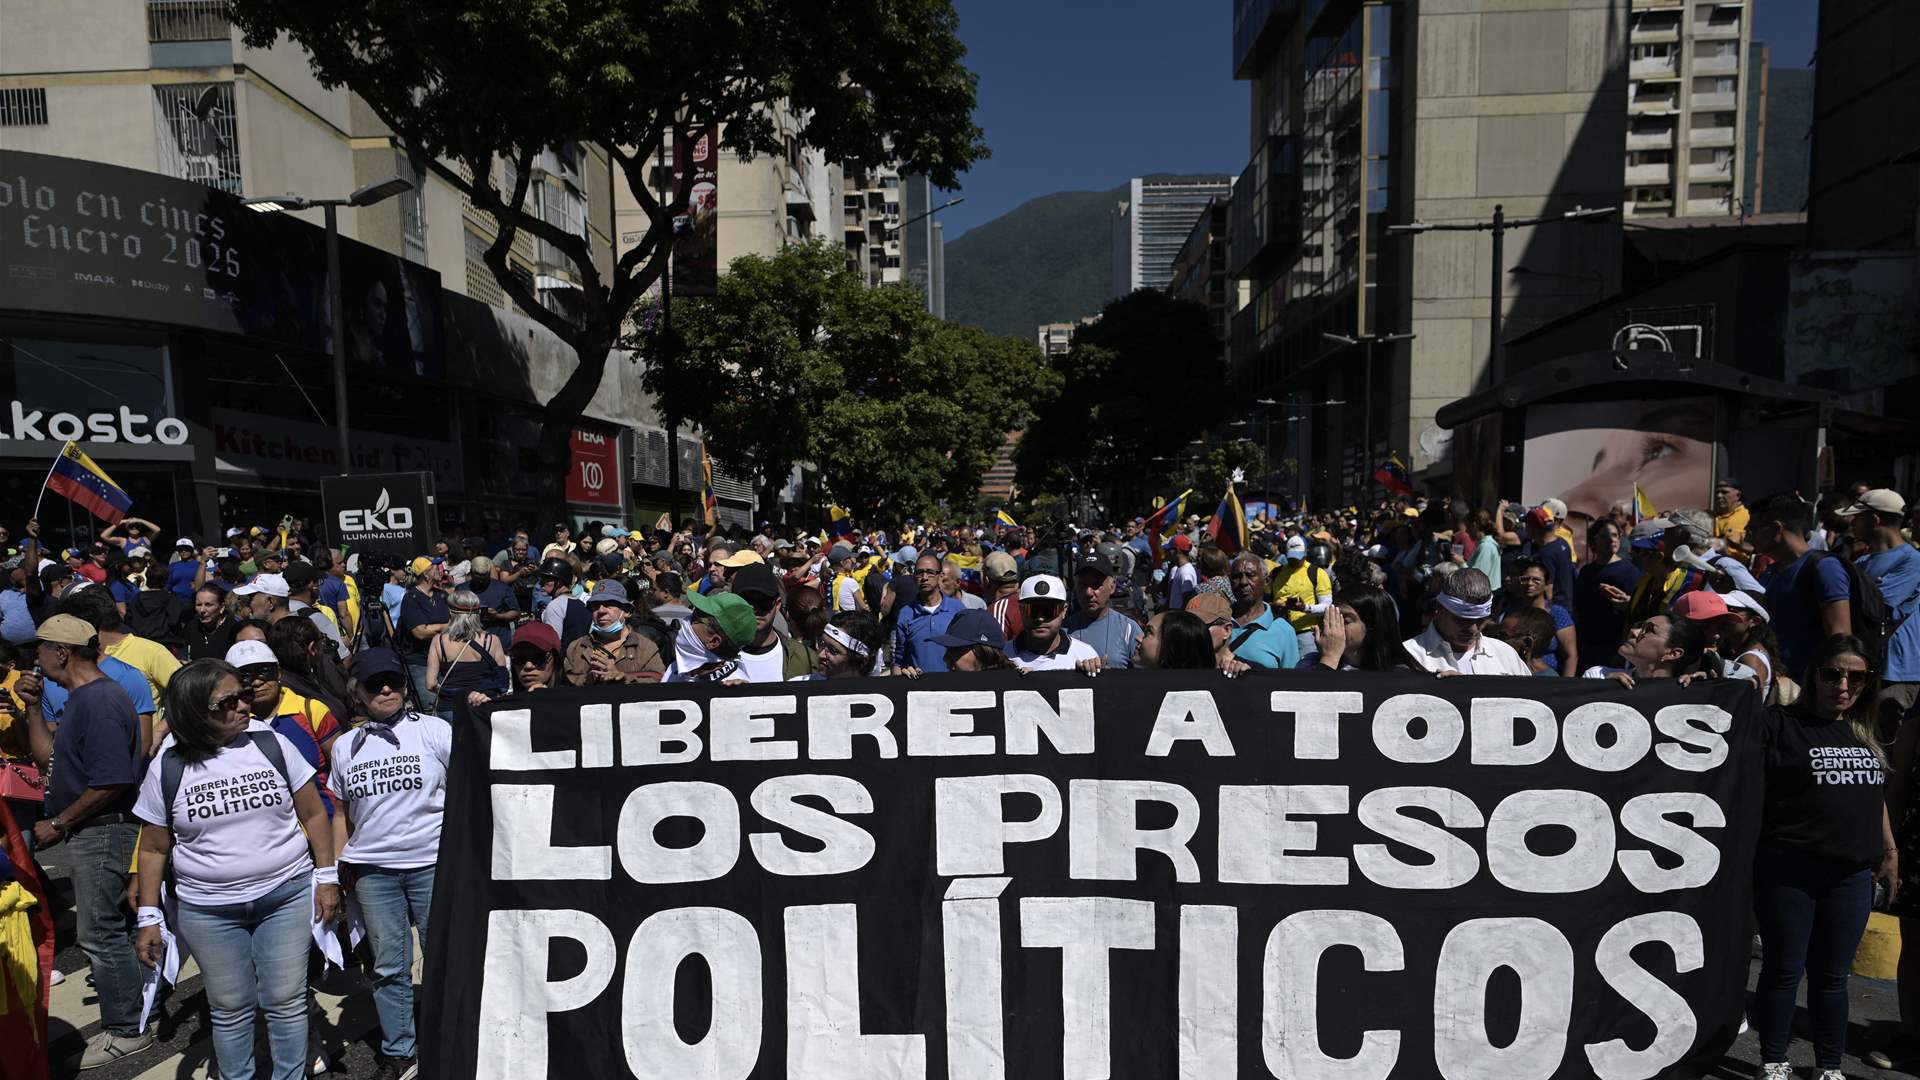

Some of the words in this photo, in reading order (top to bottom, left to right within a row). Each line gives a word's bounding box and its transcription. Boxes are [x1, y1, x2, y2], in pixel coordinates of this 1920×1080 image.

[23, 214, 142, 259] Enero
[162, 233, 240, 278] 2026
[74, 272, 116, 285] IMAX
[580, 461, 604, 490] 100
[338, 506, 413, 531] EKO
[342, 529, 413, 541] ILUMINACIÓN
[490, 688, 1096, 772] LIBEREN
[1145, 690, 1237, 757] A
[1271, 691, 1733, 773] TODOS
[347, 760, 381, 775] LIBEREN
[383, 758, 389, 766] A
[391, 755, 420, 765] TODOS
[1809, 746, 1871, 758] CIERREN
[1811, 757, 1880, 770] CENTROS
[184, 778, 229, 796] LIBEREN
[231, 776, 239, 786] A
[240, 769, 275, 784] TODOS
[347, 772, 367, 787] LOS
[371, 764, 421, 780] PRESOS
[186, 792, 216, 807] LOS
[221, 779, 278, 801] PRESOS
[348, 777, 423, 802] POLÍTICOS
[187, 792, 283, 823] POLÍTICOS
[490, 774, 876, 885] LOS
[935, 774, 1727, 894] PRESOS
[475, 875, 1705, 1080] POLÍTICOS
